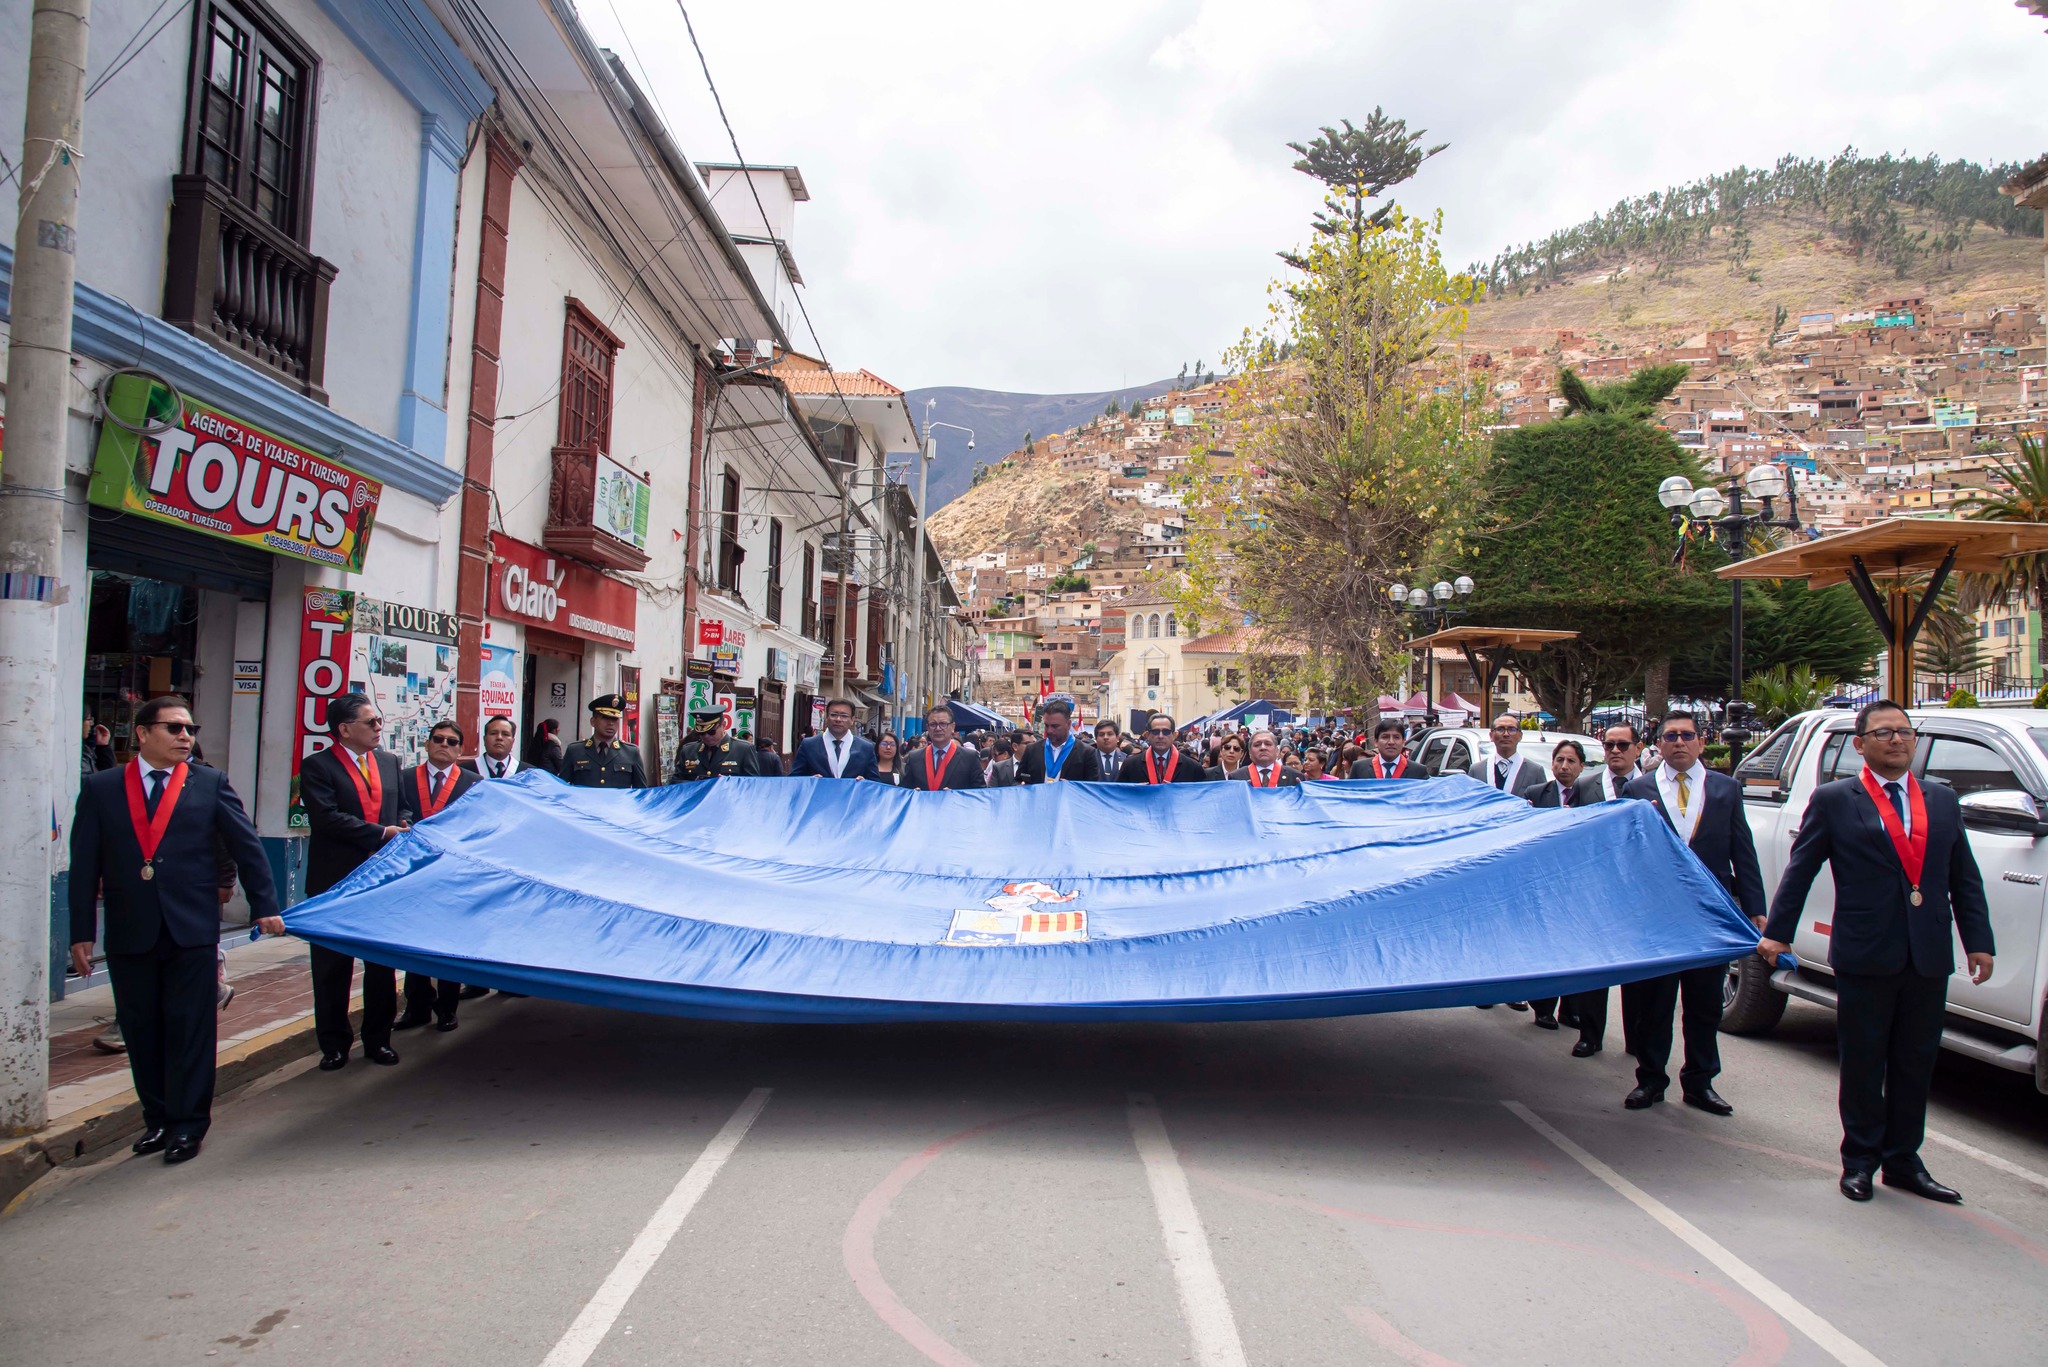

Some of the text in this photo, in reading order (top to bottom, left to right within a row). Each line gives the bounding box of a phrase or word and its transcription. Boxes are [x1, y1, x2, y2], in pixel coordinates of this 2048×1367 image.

[246, 434, 262, 454] DE
[264, 445, 299, 472] VIAJES
[301, 457, 308, 472] Y
[310, 460, 350, 489] TURISMO
[148, 417, 350, 548] TOURS
[144, 500, 232, 532] OPERADOR TURÍSTICO
[269, 534, 306, 555] 954963061
[501, 560, 562, 622] Claro
[569, 612, 634, 643] DISTRIBUIDOR AUTORIZADO
[238, 665, 258, 673] VISA
[237, 681, 257, 690] VISA
[552, 683, 565, 696] S
[481, 689, 515, 706] EQUIPAZO
[2002, 870, 2043, 886] HILUX
